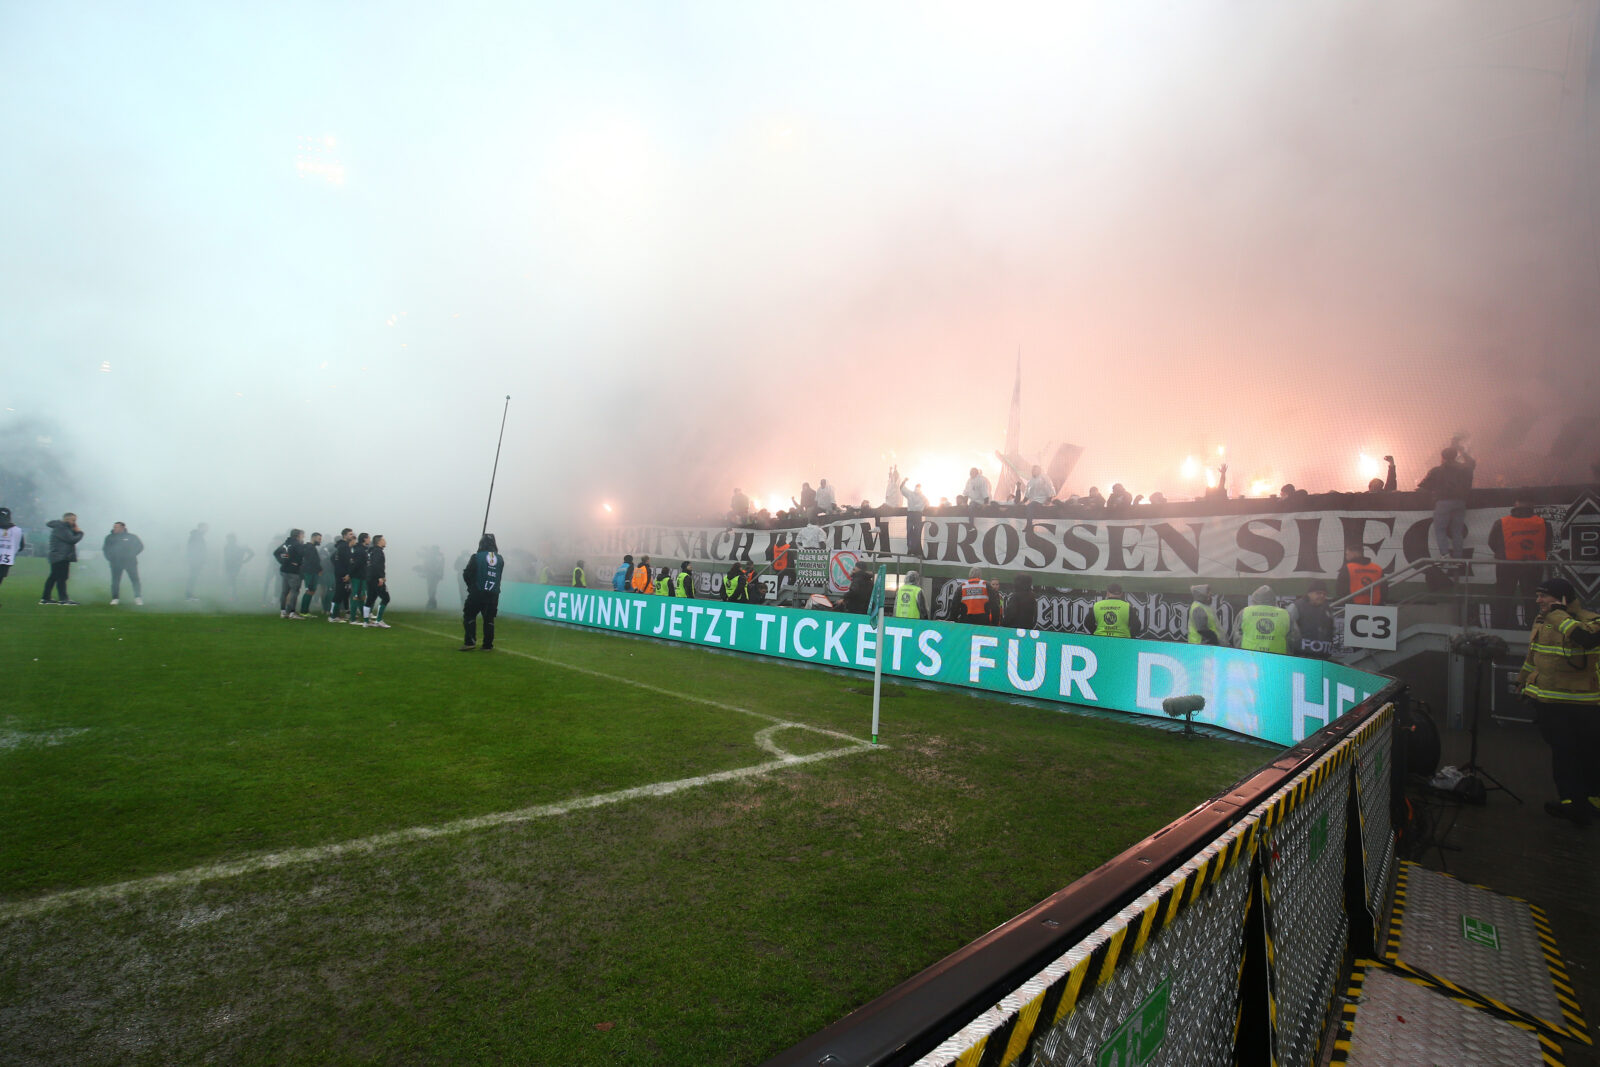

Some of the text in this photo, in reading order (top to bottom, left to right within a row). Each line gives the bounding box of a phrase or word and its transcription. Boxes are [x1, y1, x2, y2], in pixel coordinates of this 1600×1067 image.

[673, 530, 755, 562] NACH
[916, 520, 1204, 575] GROSSEN
[484, 580, 495, 591] 17
[544, 590, 647, 630] GEWINNT
[653, 602, 745, 645] JETZT
[755, 613, 943, 676] TICKETS
[969, 628, 1098, 702] FÜR
[1350, 614, 1391, 640] C3
